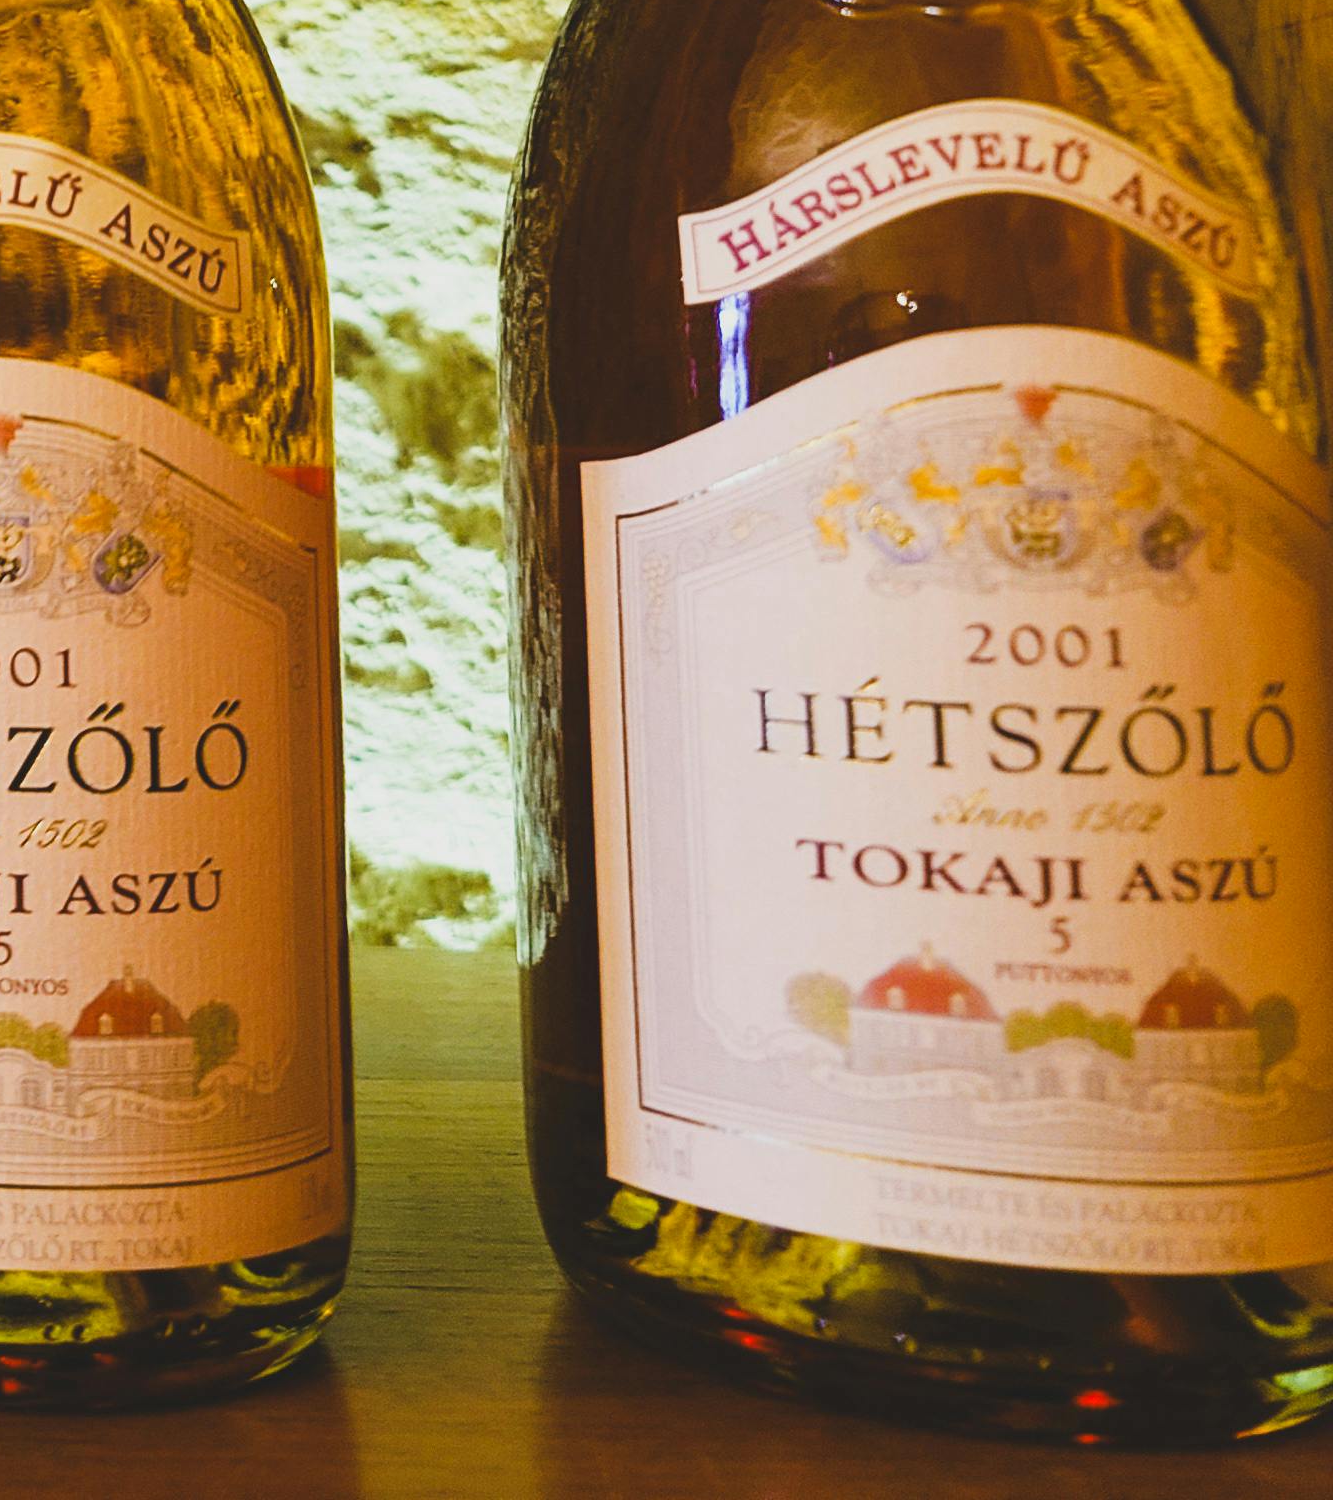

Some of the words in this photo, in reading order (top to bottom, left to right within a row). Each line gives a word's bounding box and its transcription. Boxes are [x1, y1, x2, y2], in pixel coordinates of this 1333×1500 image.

[717, 131, 1091, 273] HÁRSLEVELŰ
[1110, 173, 1238, 271] ASZÚ
[98, 204, 229, 295] ASZÚ
[965, 622, 1127, 669] 2001
[751, 675, 1296, 778] HÉTSZŐLŐ
[17, 817, 109, 850] 1502
[57, 856, 225, 916] ASZÚ
[796, 838, 1086, 909] TOKAJI
[1119, 844, 1281, 902] ASZÚ
[1050, 916, 1073, 955] 5
